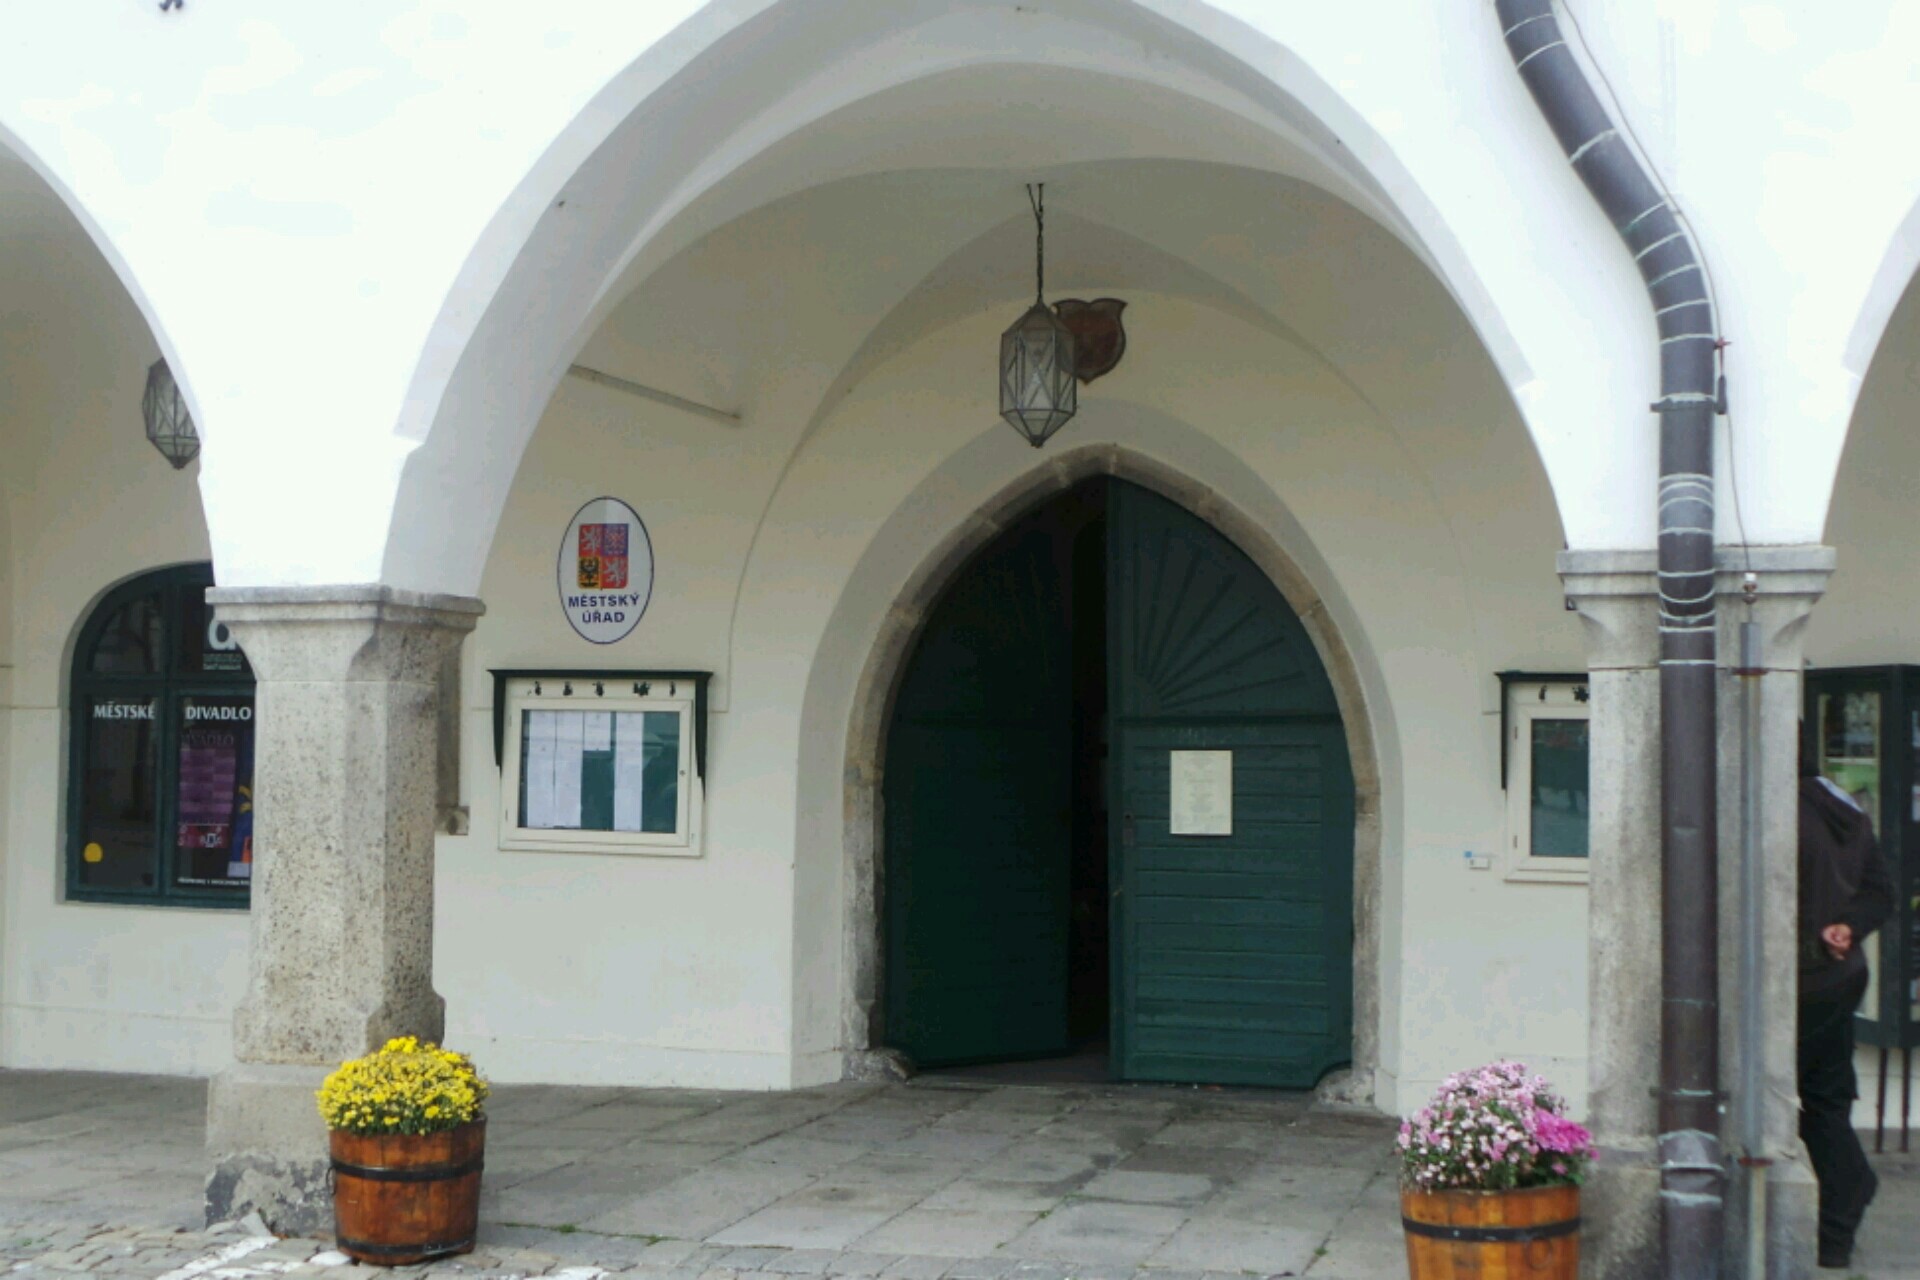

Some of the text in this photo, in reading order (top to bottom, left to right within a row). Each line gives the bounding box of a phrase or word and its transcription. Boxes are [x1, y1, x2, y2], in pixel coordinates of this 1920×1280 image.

[568, 592, 640, 607] MĚSTSKÝ
[582, 610, 625, 623] ÚŘAD
[93, 701, 252, 720] MĚSTSKÉ DIVADLO
